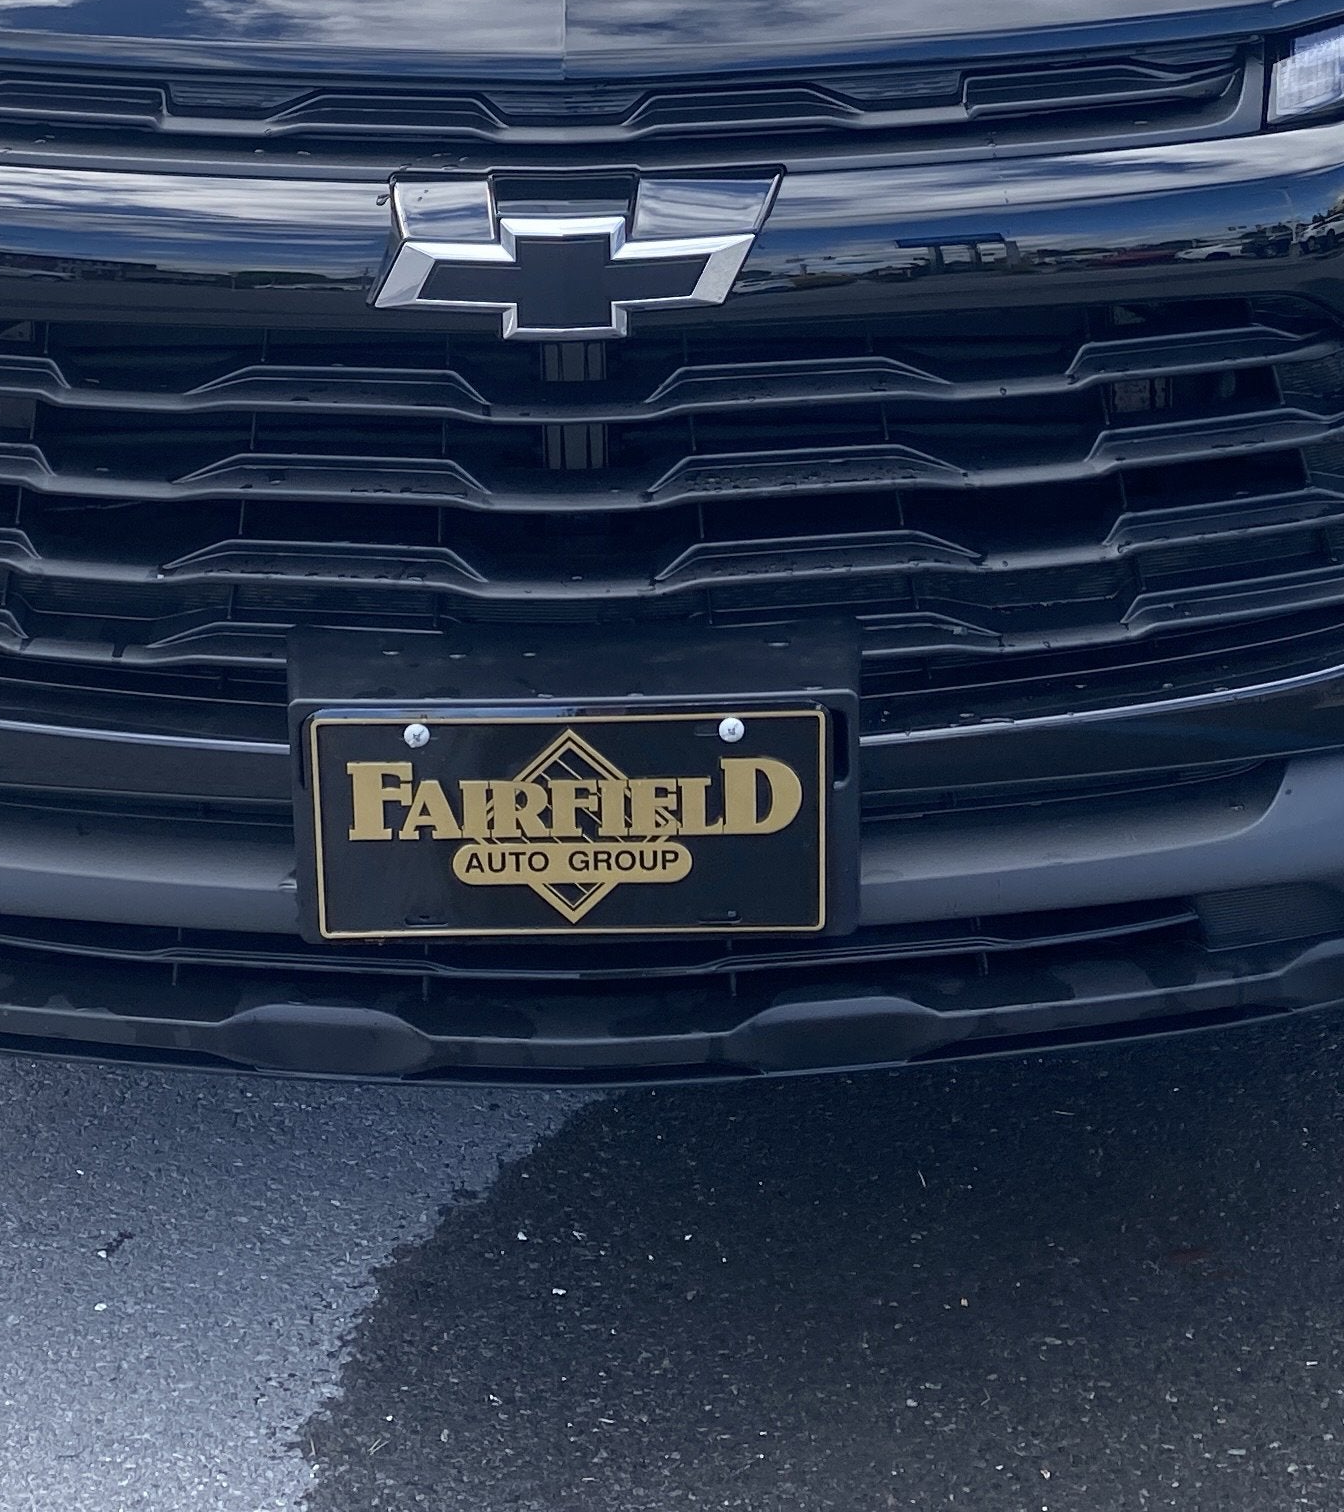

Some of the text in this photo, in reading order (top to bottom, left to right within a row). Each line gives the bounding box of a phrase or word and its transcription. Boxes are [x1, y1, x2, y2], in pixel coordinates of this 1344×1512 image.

[346, 756, 803, 842] FAIRFIELD
[464, 850, 680, 874] AUTO GROUP
